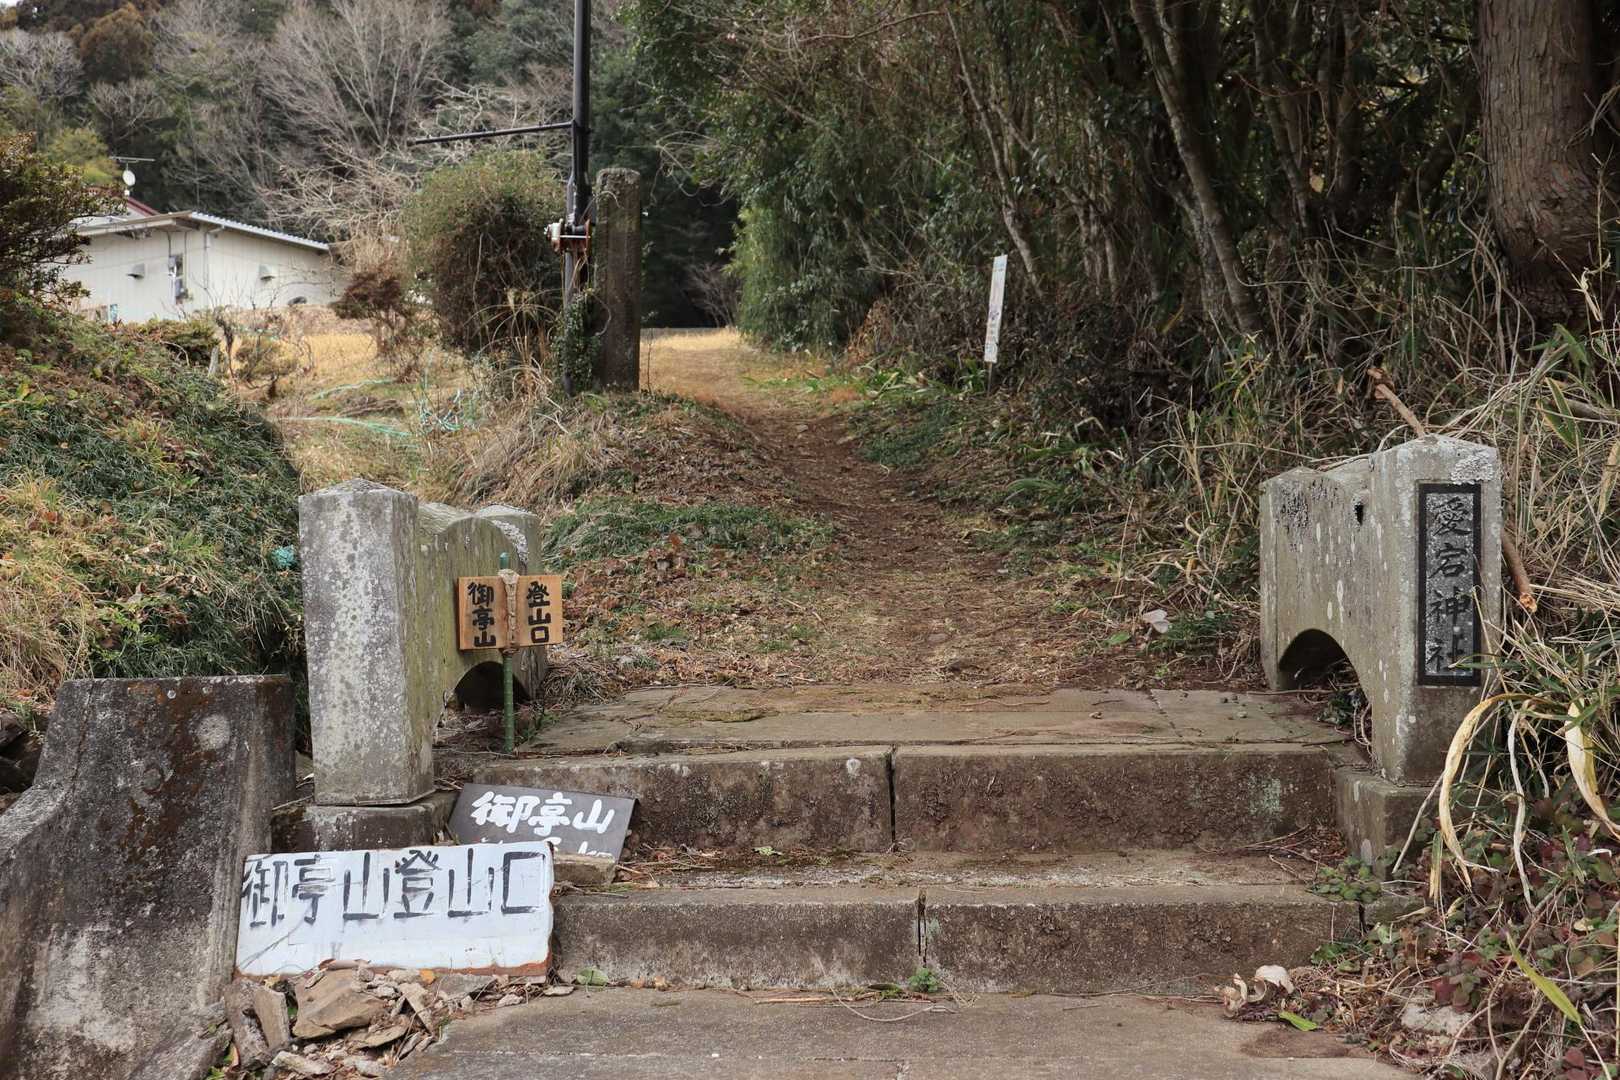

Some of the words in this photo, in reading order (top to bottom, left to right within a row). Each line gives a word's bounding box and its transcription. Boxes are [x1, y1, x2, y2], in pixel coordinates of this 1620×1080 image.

[467, 582, 497, 648] 御亭山
[526, 580, 552, 644] 登山口
[1426, 496, 1473, 674] 愛宕神社
[471, 791, 615, 836] 御亭山
[241, 848, 546, 928] 御亭山登山口
